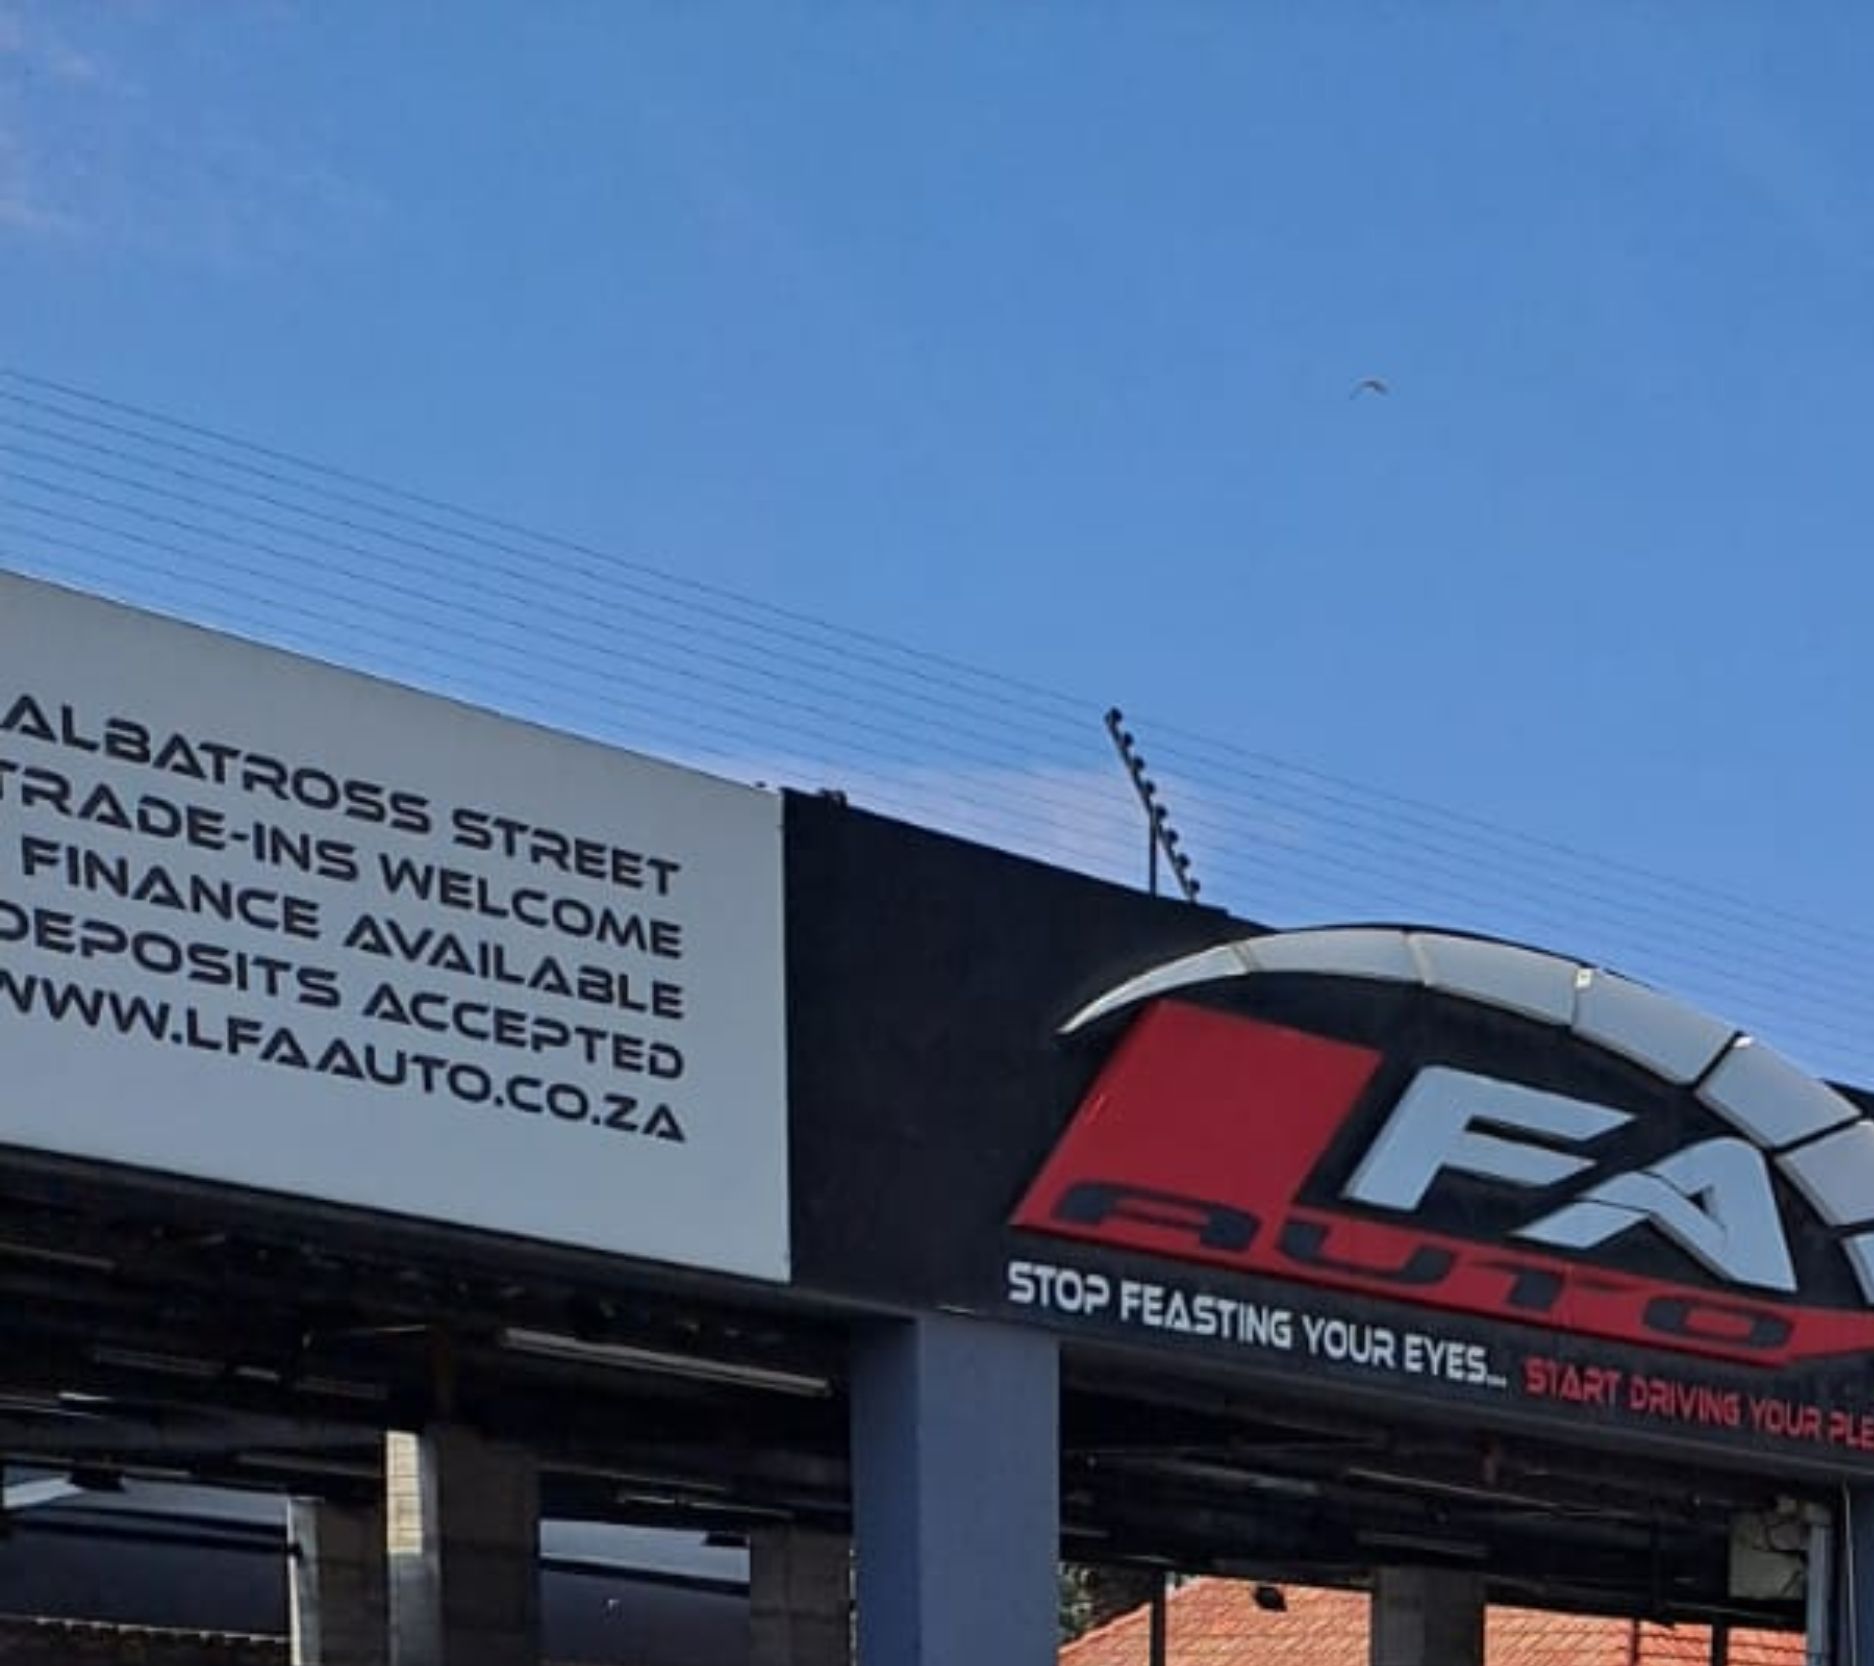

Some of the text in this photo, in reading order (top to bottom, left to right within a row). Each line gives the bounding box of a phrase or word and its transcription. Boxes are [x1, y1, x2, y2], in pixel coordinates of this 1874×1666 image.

[1, 694, 681, 896] ALBATROSS STREET
[0, 901, 685, 1079] DEPOSITS ACCEPTED
[22, 834, 684, 1020] FINANCE AVAILABLE
[379, 853, 682, 960] WELCOME
[1008, 1261, 1110, 1315] STOP
[1120, 1280, 1293, 1349] FEASTING
[1301, 1314, 1395, 1368] YOUR
[1524, 1357, 1621, 1402] START
[1629, 1375, 1740, 1428] DRIVING
[1749, 1397, 1822, 1441] YOUR
[1050, 1180, 1796, 1347] AUTO
